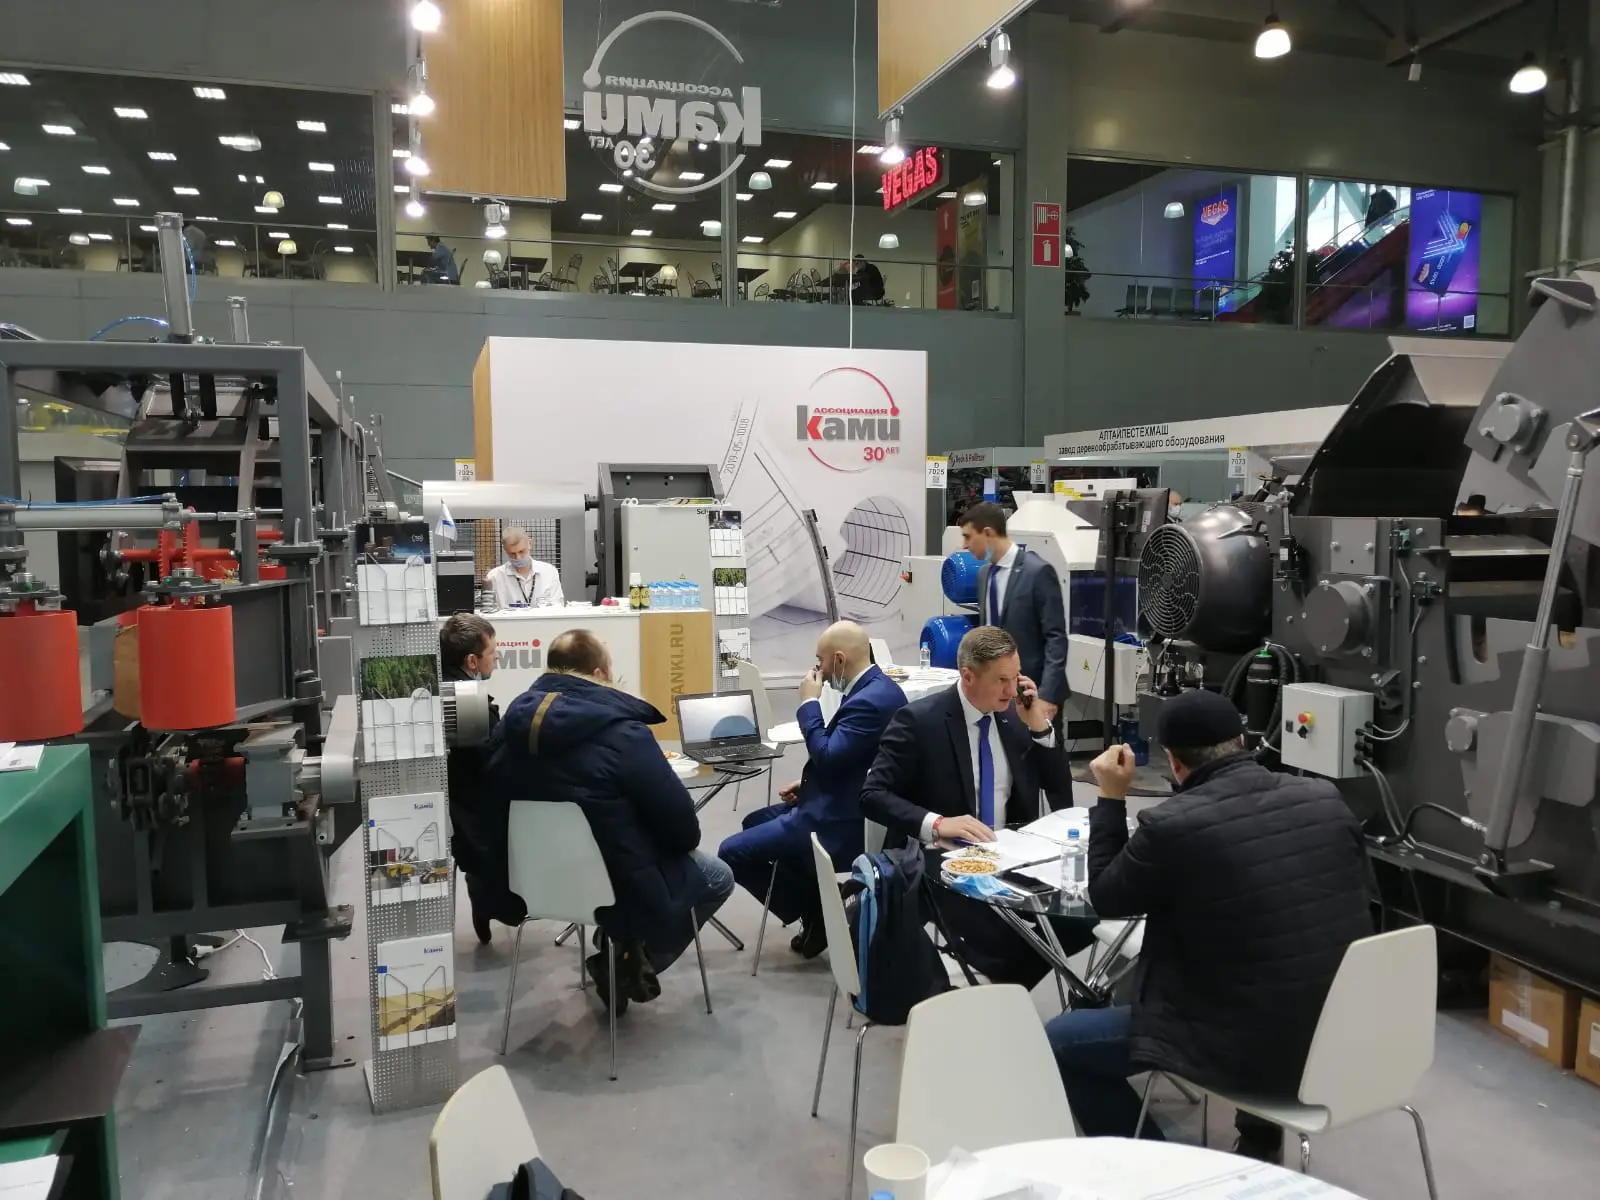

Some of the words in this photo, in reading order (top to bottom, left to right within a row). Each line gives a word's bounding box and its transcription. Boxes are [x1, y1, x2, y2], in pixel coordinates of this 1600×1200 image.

[881, 146, 938, 211] VEGAS
[1202, 199, 1229, 218] VEGAS
[814, 407, 888, 415] АССОЦИАЦИЯ
[863, 446, 885, 462] 30
[885, 446, 899, 455] ЛЕТ
[1058, 446, 1076, 456] завод
[1076, 440, 1164, 455] деревообрабатывающего
[1165, 434, 1225, 449] оборудования
